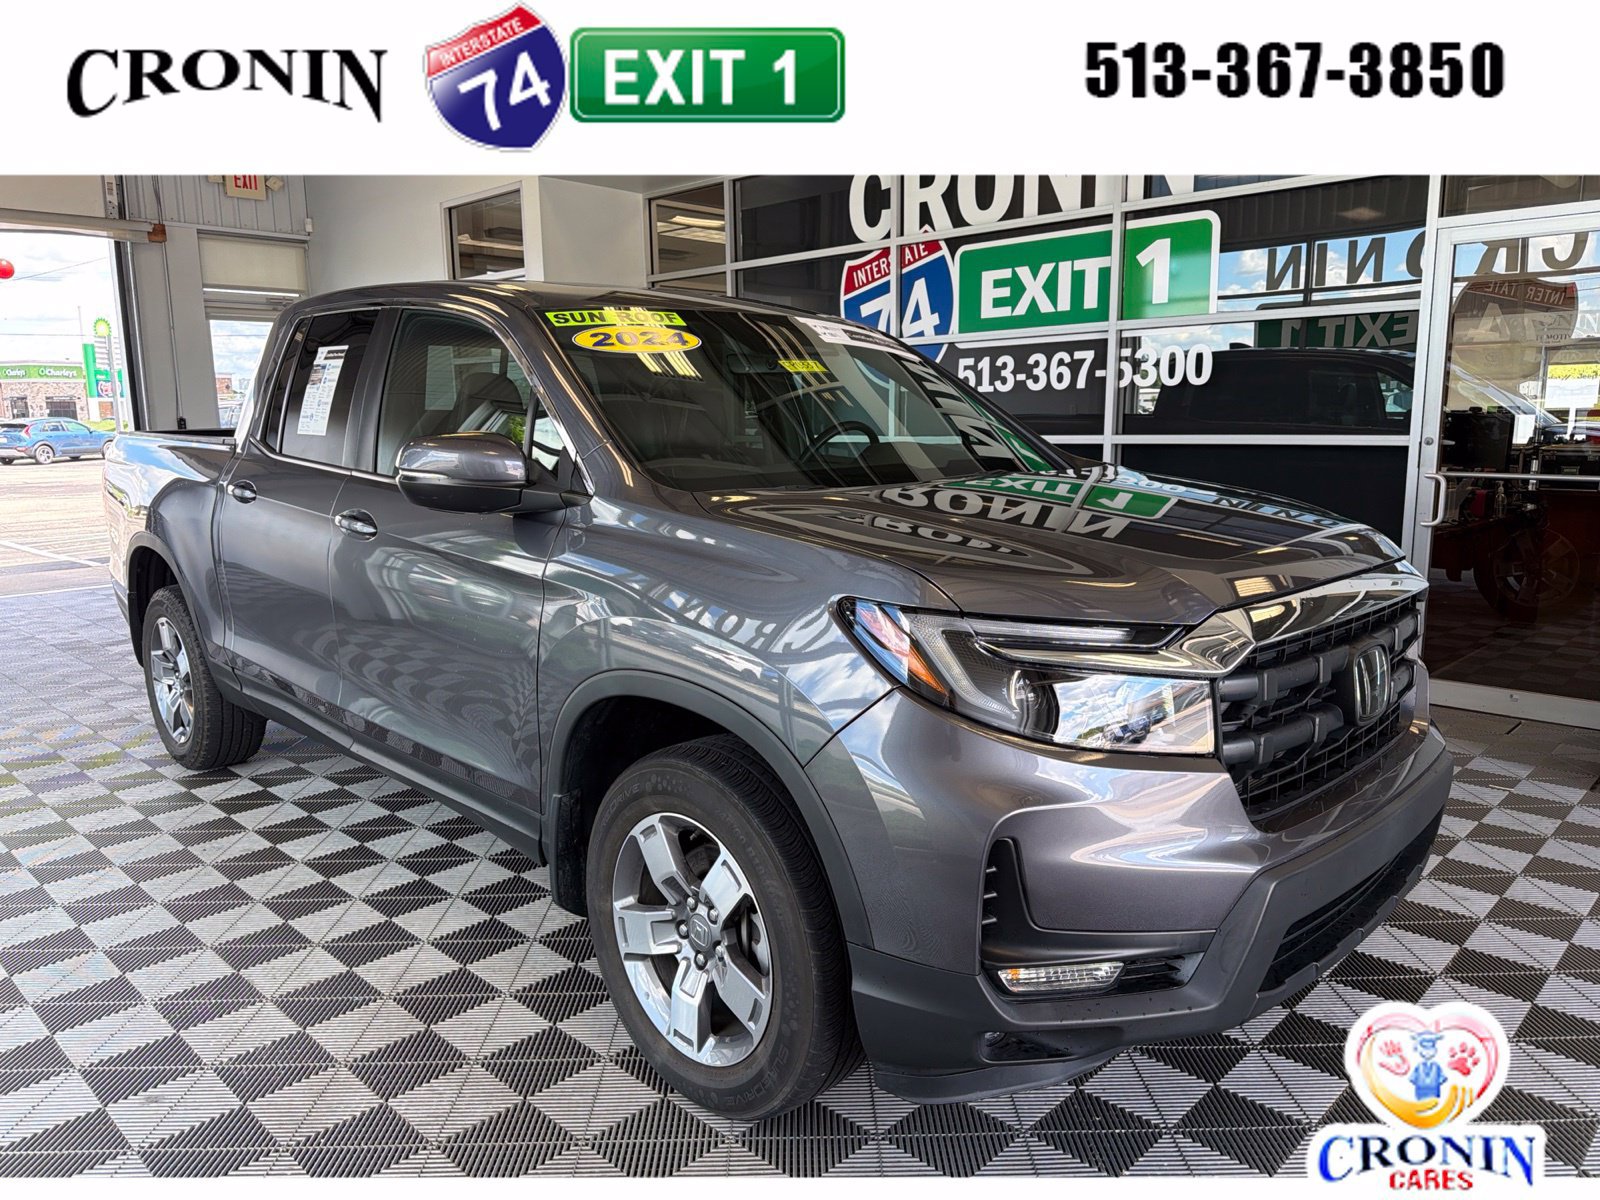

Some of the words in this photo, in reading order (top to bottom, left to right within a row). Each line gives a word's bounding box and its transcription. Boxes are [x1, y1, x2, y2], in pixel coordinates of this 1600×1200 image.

[853, 242, 929, 288] INTERATE
[980, 255, 1113, 319] EXIT
[1136, 238, 1171, 305] 1
[554, 311, 607, 325] SUN
[615, 310, 680, 325] ROOF
[859, 277, 940, 338] 74
[589, 331, 691, 347] 2024
[956, 343, 1213, 393] 513-367-5300
